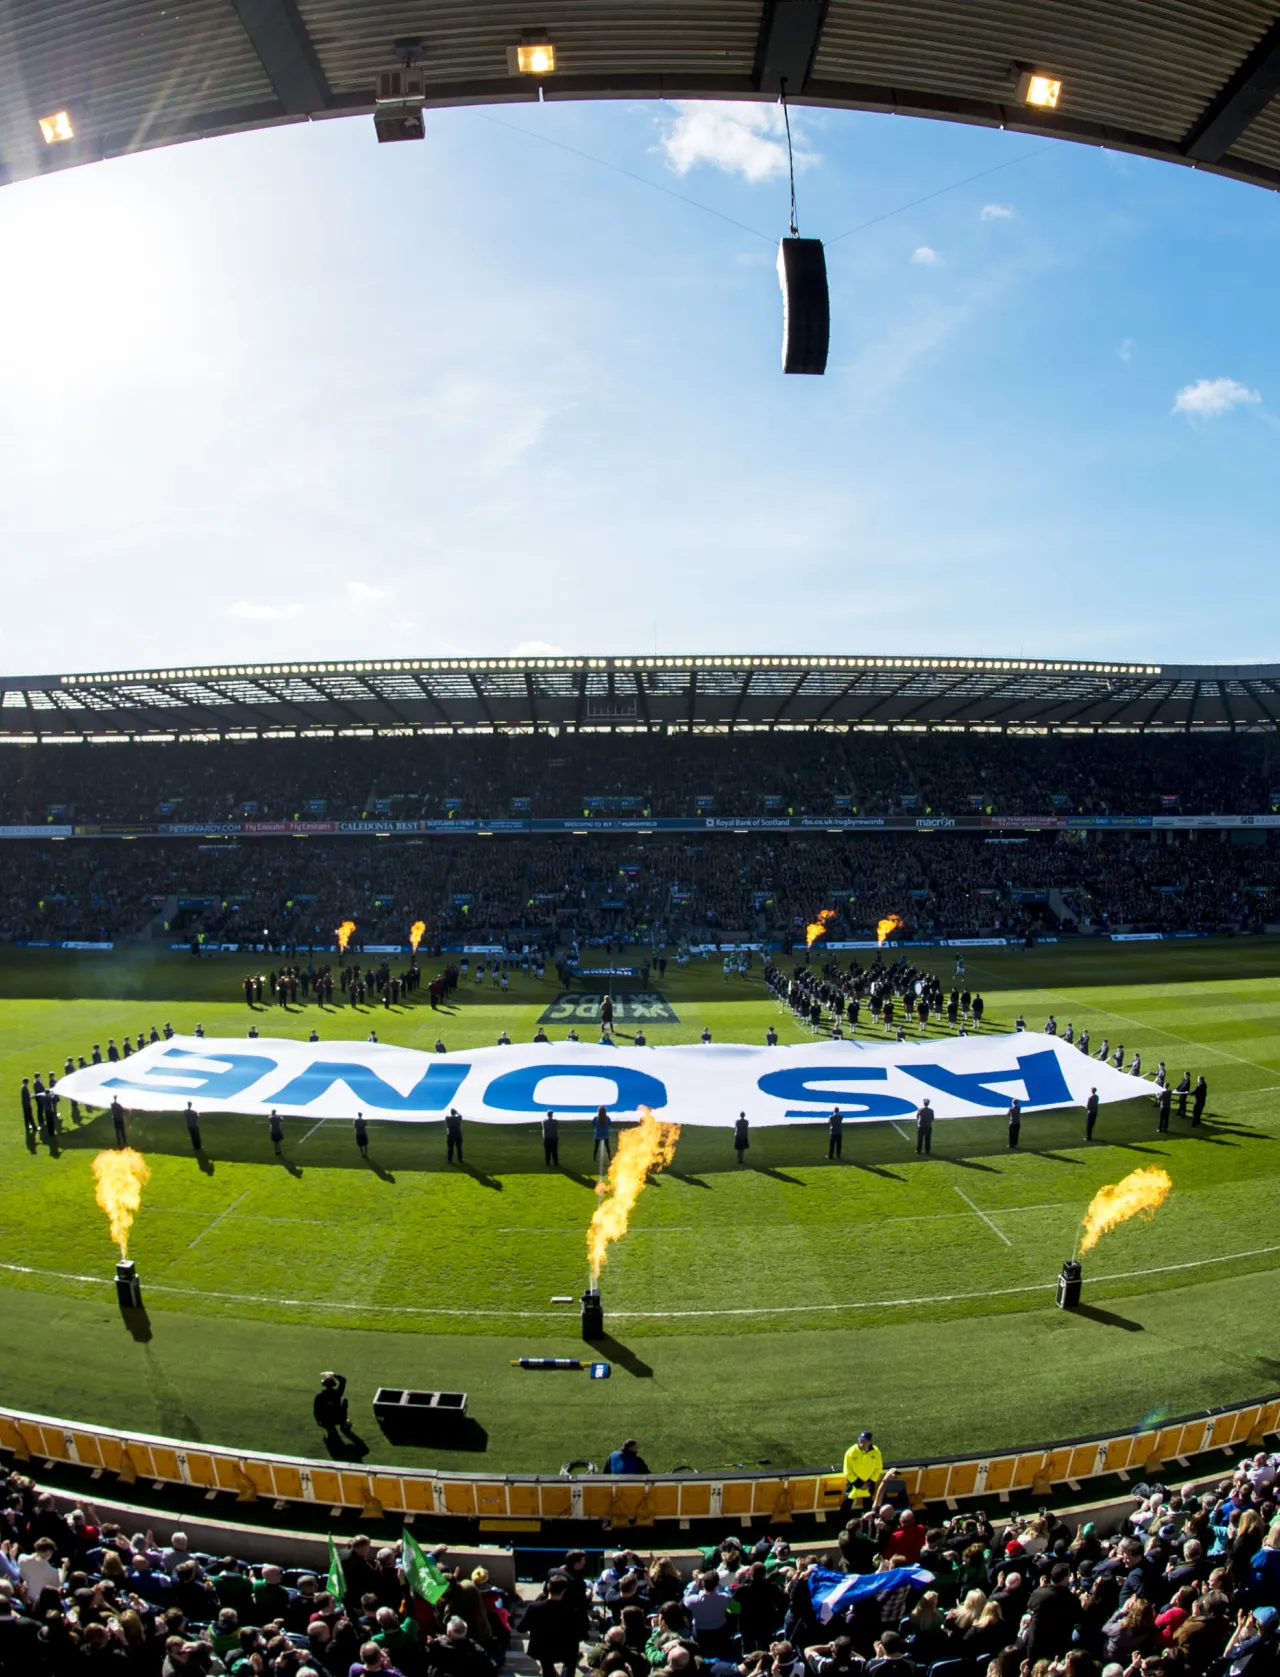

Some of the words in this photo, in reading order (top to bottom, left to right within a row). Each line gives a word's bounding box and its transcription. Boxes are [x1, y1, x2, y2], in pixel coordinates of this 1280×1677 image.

[341, 822, 394, 831] CALEDONIA
[396, 822, 419, 830] BEST
[716, 819, 734, 828] Royal
[802, 818, 885, 827] rbs.co.uk/rugbyrewards
[168, 823, 241, 832] PETERVARDY.COM
[100, 1047, 669, 1114] ONE
[757, 1049, 1075, 1120] AS
